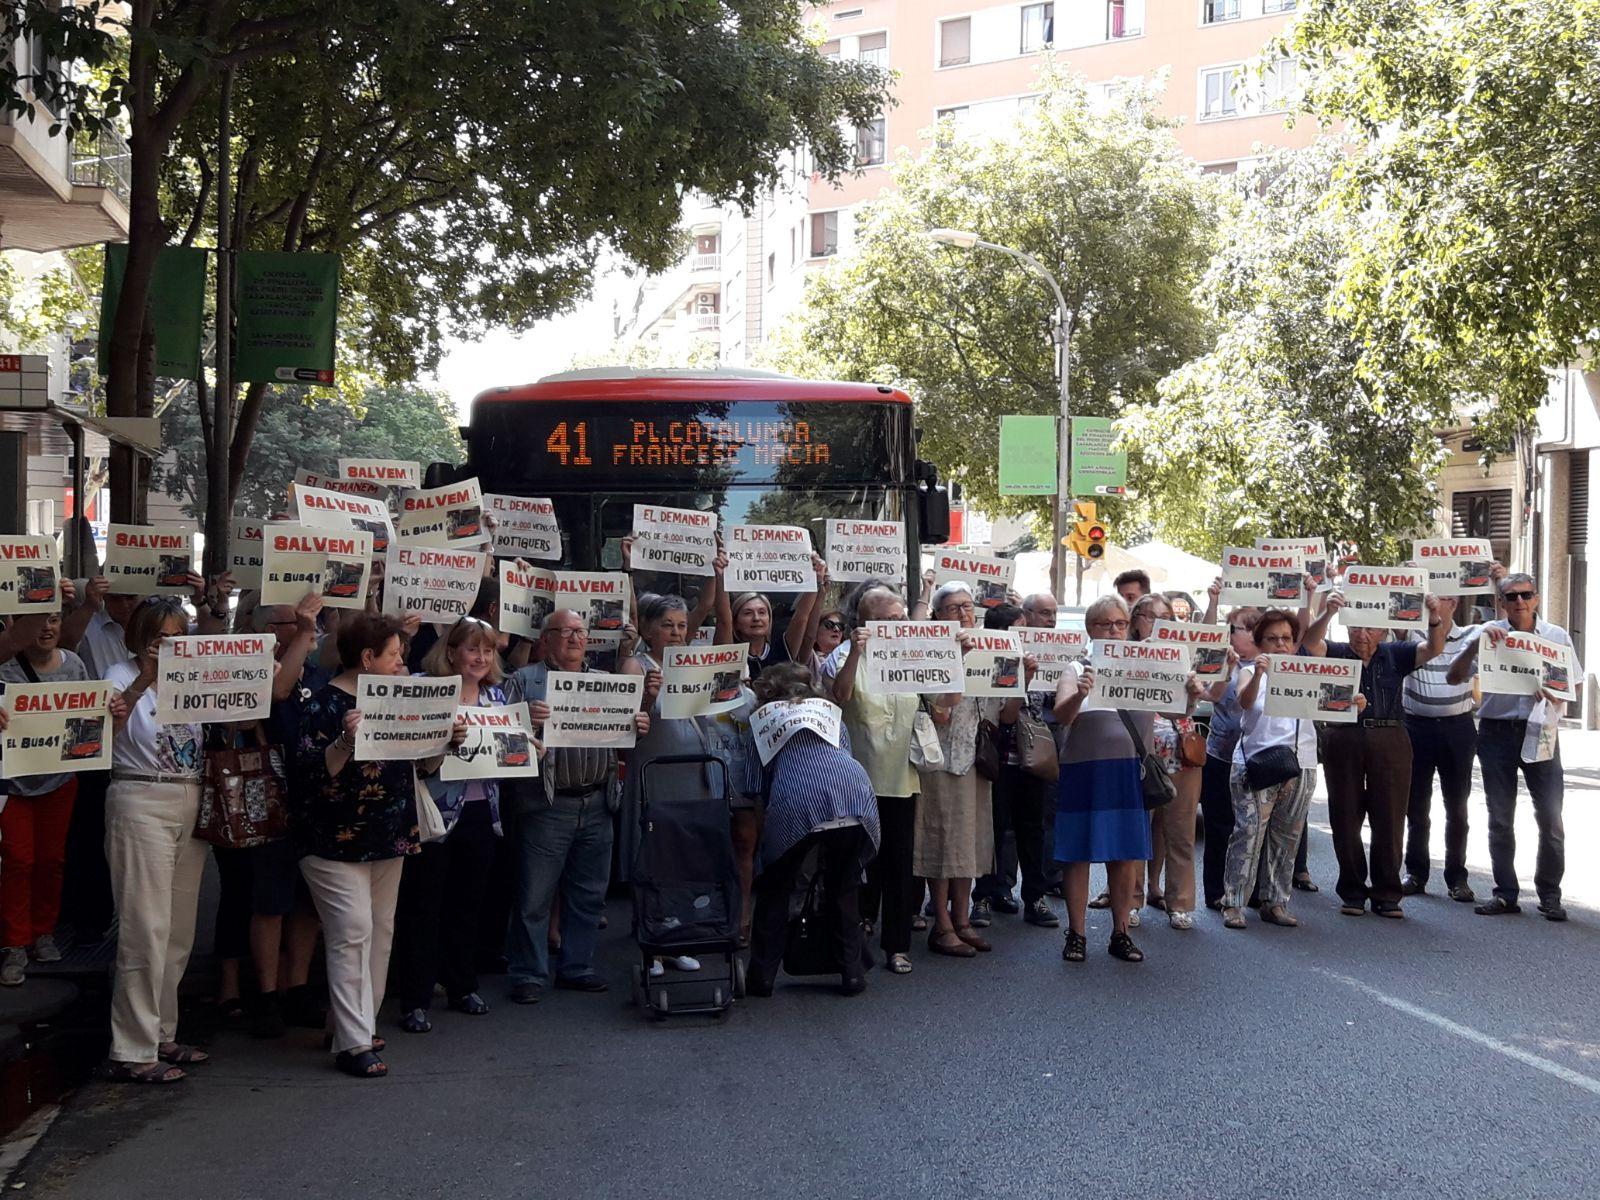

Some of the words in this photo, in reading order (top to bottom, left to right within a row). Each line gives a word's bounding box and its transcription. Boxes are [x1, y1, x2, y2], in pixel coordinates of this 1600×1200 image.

[547, 421, 592, 465] 41
[348, 466, 406, 479] SALVEM
[304, 495, 372, 514] SALVEM
[405, 490, 469, 511] SALVEM
[494, 498, 506, 511] EL
[644, 509, 656, 522] EL
[660, 511, 710, 526] DEMANEM
[734, 528, 748, 542] EL
[752, 529, 803, 543] DEMANEM
[836, 523, 849, 536] EL
[852, 524, 897, 536] DEMANEM
[116, 533, 181, 549] SALVEM
[274, 536, 354, 554] SALVEM
[498, 536, 551, 551] BOTIGUERS
[649, 549, 705, 567] BOTIGUERS
[1420, 545, 1479, 557] SALVEM
[234, 557, 245, 565] EL
[399, 550, 415, 565] EL
[420, 553, 475, 569] DEMANEM
[941, 557, 1001, 576] SALVEM
[1229, 554, 1292, 568] SALVEM
[842, 561, 894, 575] BOTIGUERS
[411, 577, 420, 585] DE
[743, 569, 804, 583] BOTIGUERS
[1348, 573, 1414, 587] SALVEM
[555, 580, 614, 593] ALVEM
[406, 596, 467, 615] BOTIGUERS
[504, 603, 510, 611] EL
[877, 625, 891, 639] EL
[895, 625, 950, 639] DEMANEM
[1018, 631, 1030, 643] EL
[1033, 632, 1081, 643] DEMANEM
[1158, 628, 1222, 642] SALVEM
[174, 641, 192, 658] EL
[197, 639, 264, 656] DEMANEM
[890, 651, 898, 659] DE
[1104, 644, 1119, 658] EL
[1123, 645, 1180, 660] DEMANEM
[1505, 636, 1558, 660] SALVEM
[675, 651, 739, 665] SALVEMOS
[188, 671, 199, 681] DE
[888, 669, 950, 683] BOTIGUERS
[1114, 669, 1123, 677] DE
[1280, 662, 1349, 676] SALVEMOS
[366, 684, 388, 698] LO
[392, 684, 456, 698] PEDIMOS
[555, 680, 573, 692] LO
[577, 681, 636, 693] PEDIMOS
[667, 685, 679, 694] EL
[681, 683, 700, 694] BUS
[1270, 687, 1280, 695] EL
[1284, 688, 1303, 698] BUS
[1306, 689, 1318, 698] 41
[183, 692, 258, 710] BOTIGUERS
[1109, 686, 1173, 703] BOTIGUERS
[15, 692, 96, 712] SALVEM
[385, 713, 396, 721] DE
[758, 707, 771, 719] EL
[552, 722, 558, 730] Y
[7, 739, 16, 748] EL
[364, 733, 370, 741] Y
